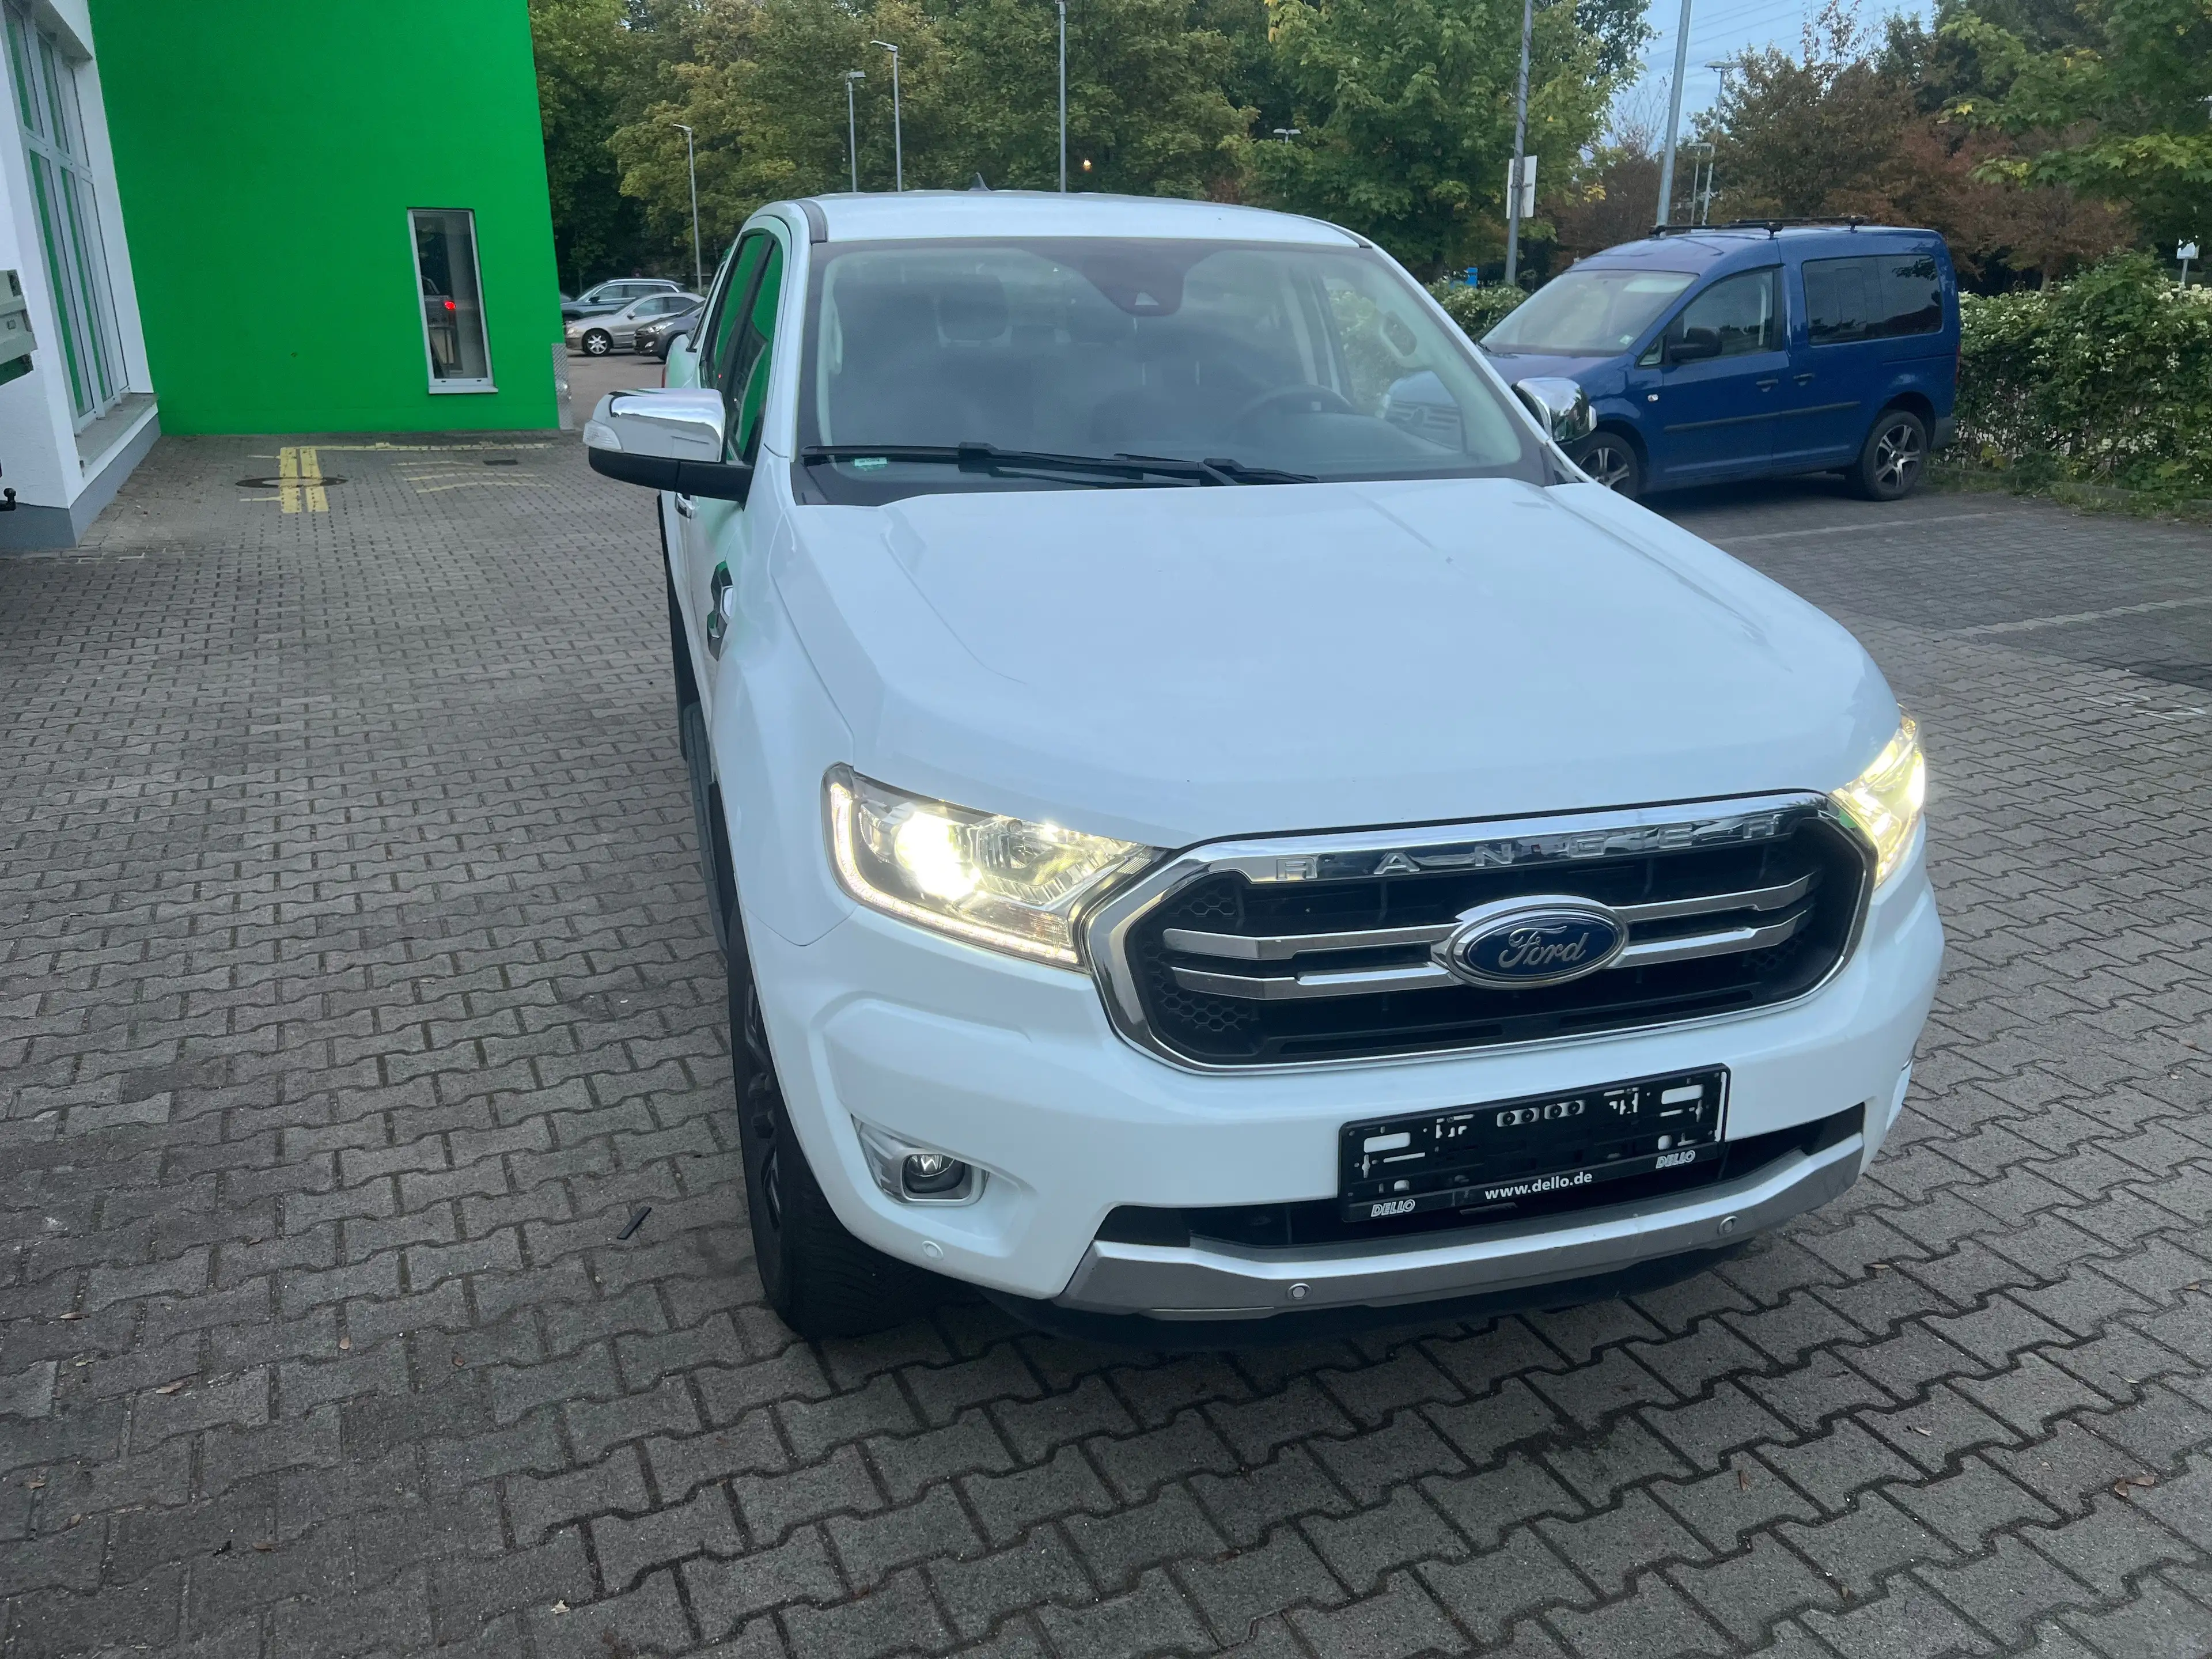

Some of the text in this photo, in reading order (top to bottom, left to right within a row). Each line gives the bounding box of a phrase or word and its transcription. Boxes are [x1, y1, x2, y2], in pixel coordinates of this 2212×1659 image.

[1277, 813, 1783, 880] RANGER
[1499, 925, 1589, 969] Ford
[1656, 1150, 1696, 1169] DELLO
[1485, 1172, 1592, 1200] www.dello.de
[1371, 1199, 1415, 1217] DELLO
